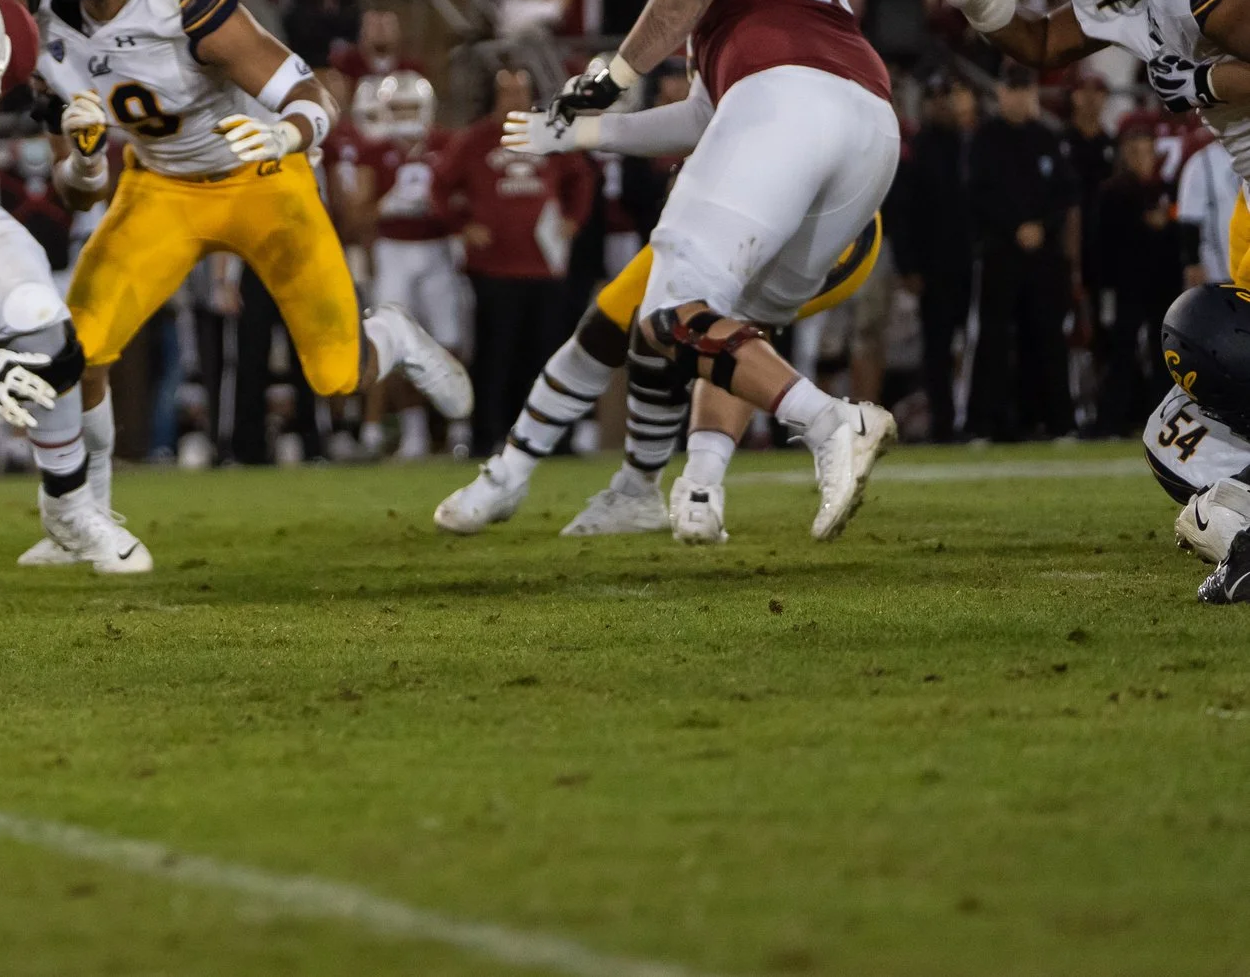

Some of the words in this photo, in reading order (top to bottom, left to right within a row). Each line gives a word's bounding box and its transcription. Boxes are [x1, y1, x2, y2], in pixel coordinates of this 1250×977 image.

[88, 55, 112, 78] Cal
[107, 80, 182, 136] 9
[1158, 408, 1209, 462] 54
